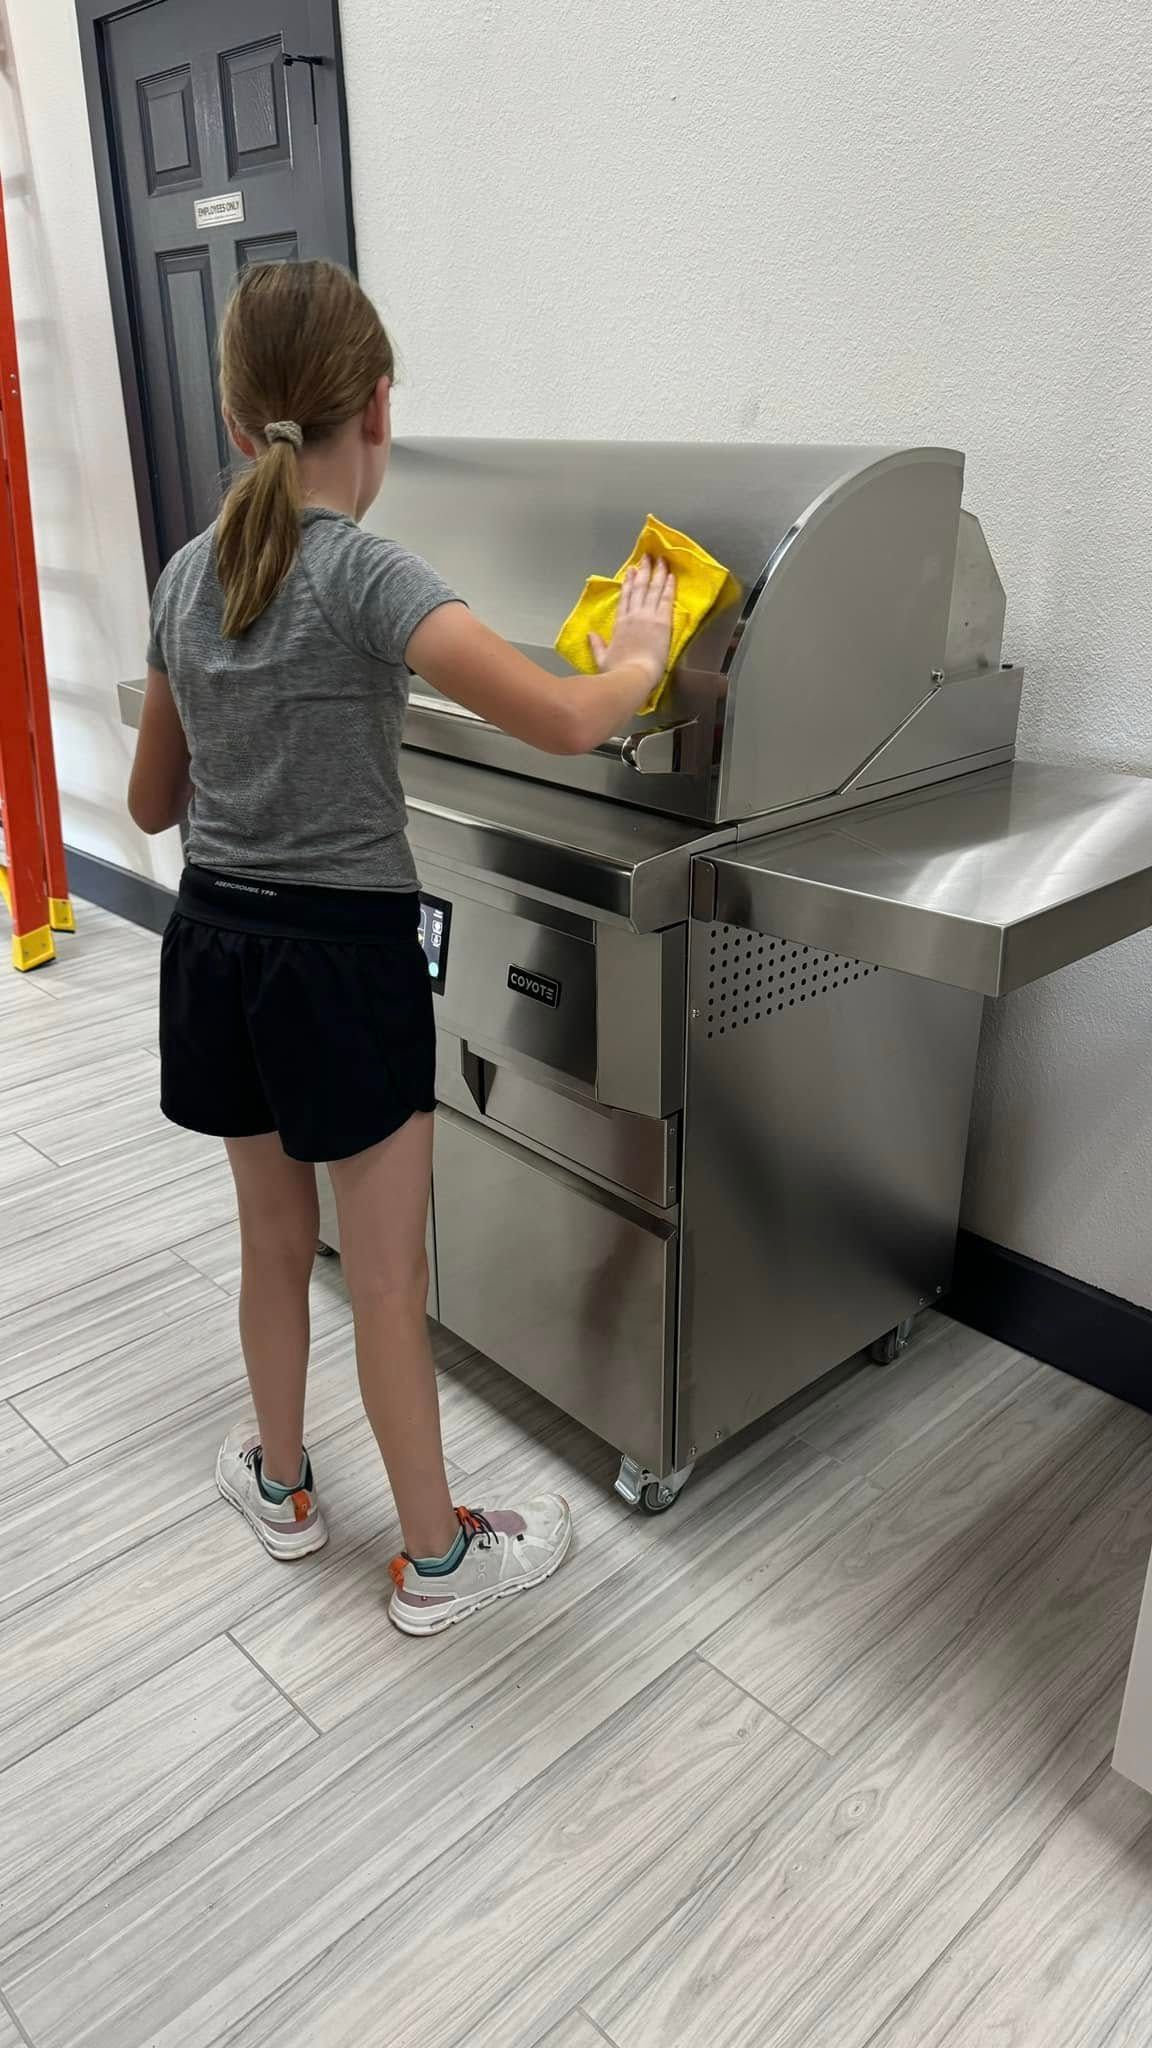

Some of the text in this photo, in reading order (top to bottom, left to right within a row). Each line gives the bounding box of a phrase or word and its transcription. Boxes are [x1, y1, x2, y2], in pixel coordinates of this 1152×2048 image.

[198, 203, 225, 217] EMPLOYEES
[226, 200, 239, 211] ONLY
[214, 880, 259, 894] ABERCROMBIE
[511, 973, 554, 1000] COYOTE
